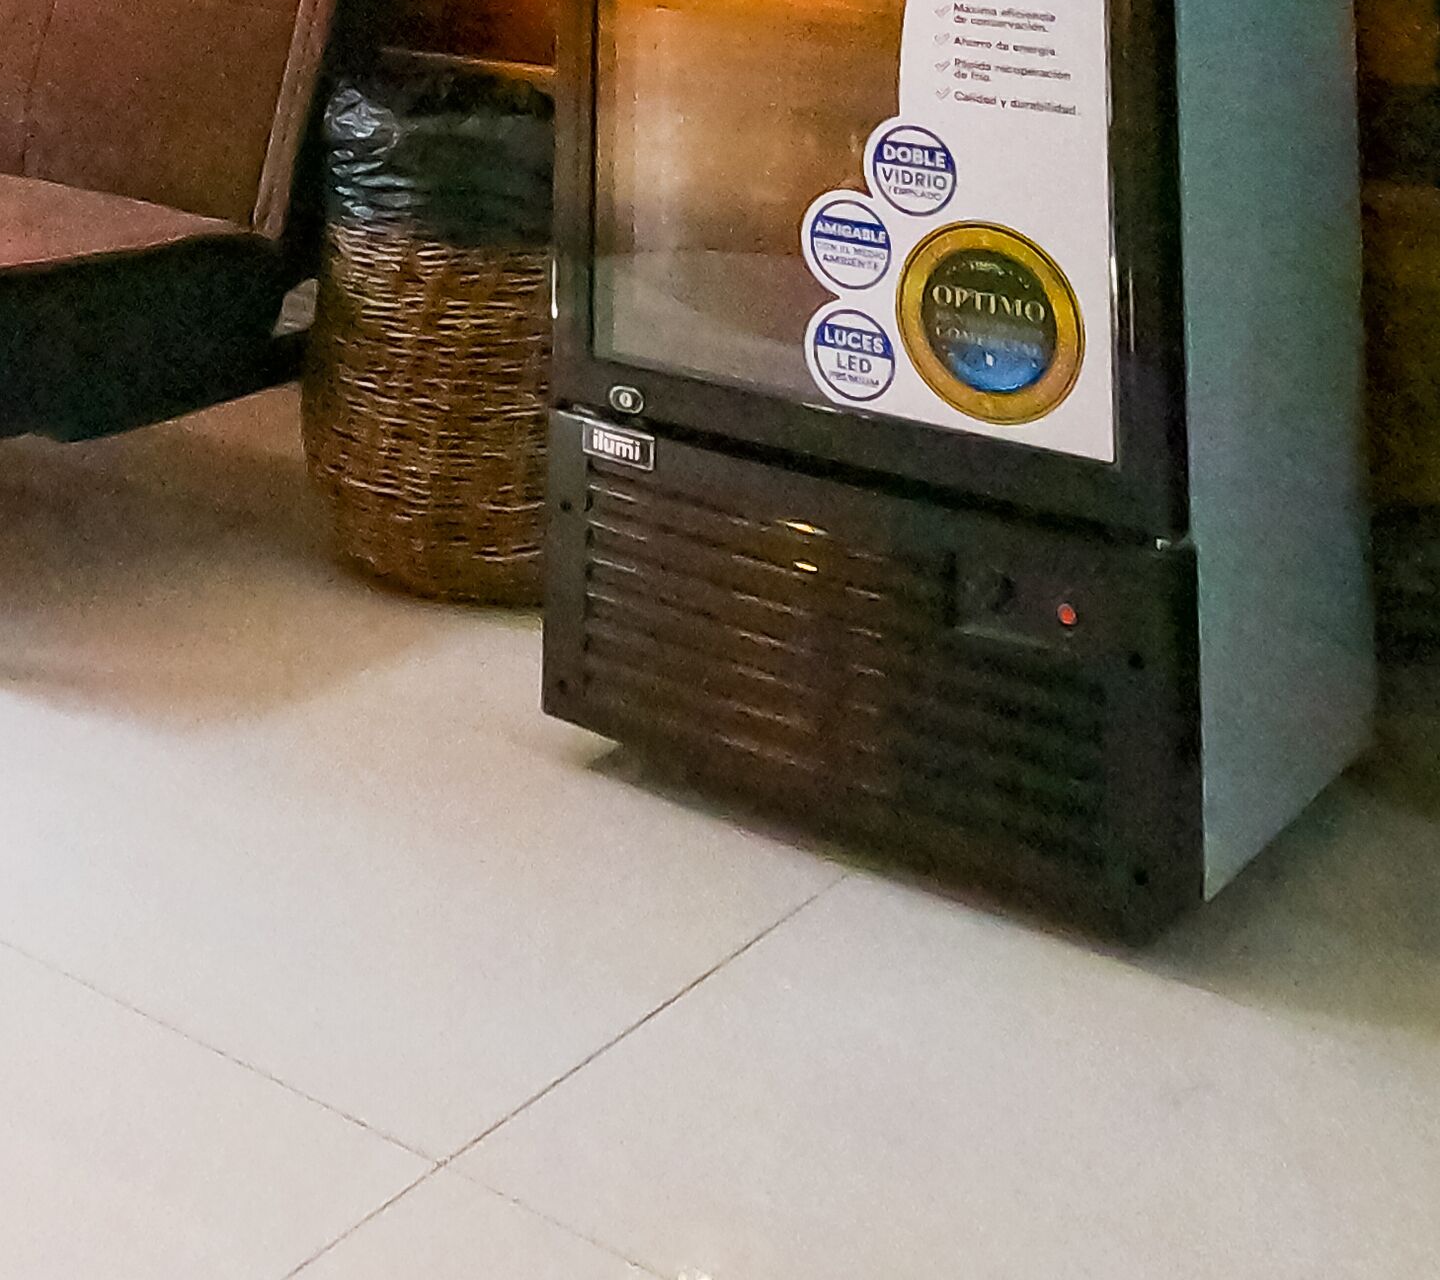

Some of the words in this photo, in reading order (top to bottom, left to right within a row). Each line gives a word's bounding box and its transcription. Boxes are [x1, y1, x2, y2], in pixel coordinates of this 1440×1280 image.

[883, 143, 947, 168] DOBLE
[882, 167, 948, 190] VIDRIO
[815, 220, 887, 243] AMIGABLE
[824, 325, 885, 354] LUCES
[836, 351, 873, 374] LED
[593, 428, 641, 461] ilumi
